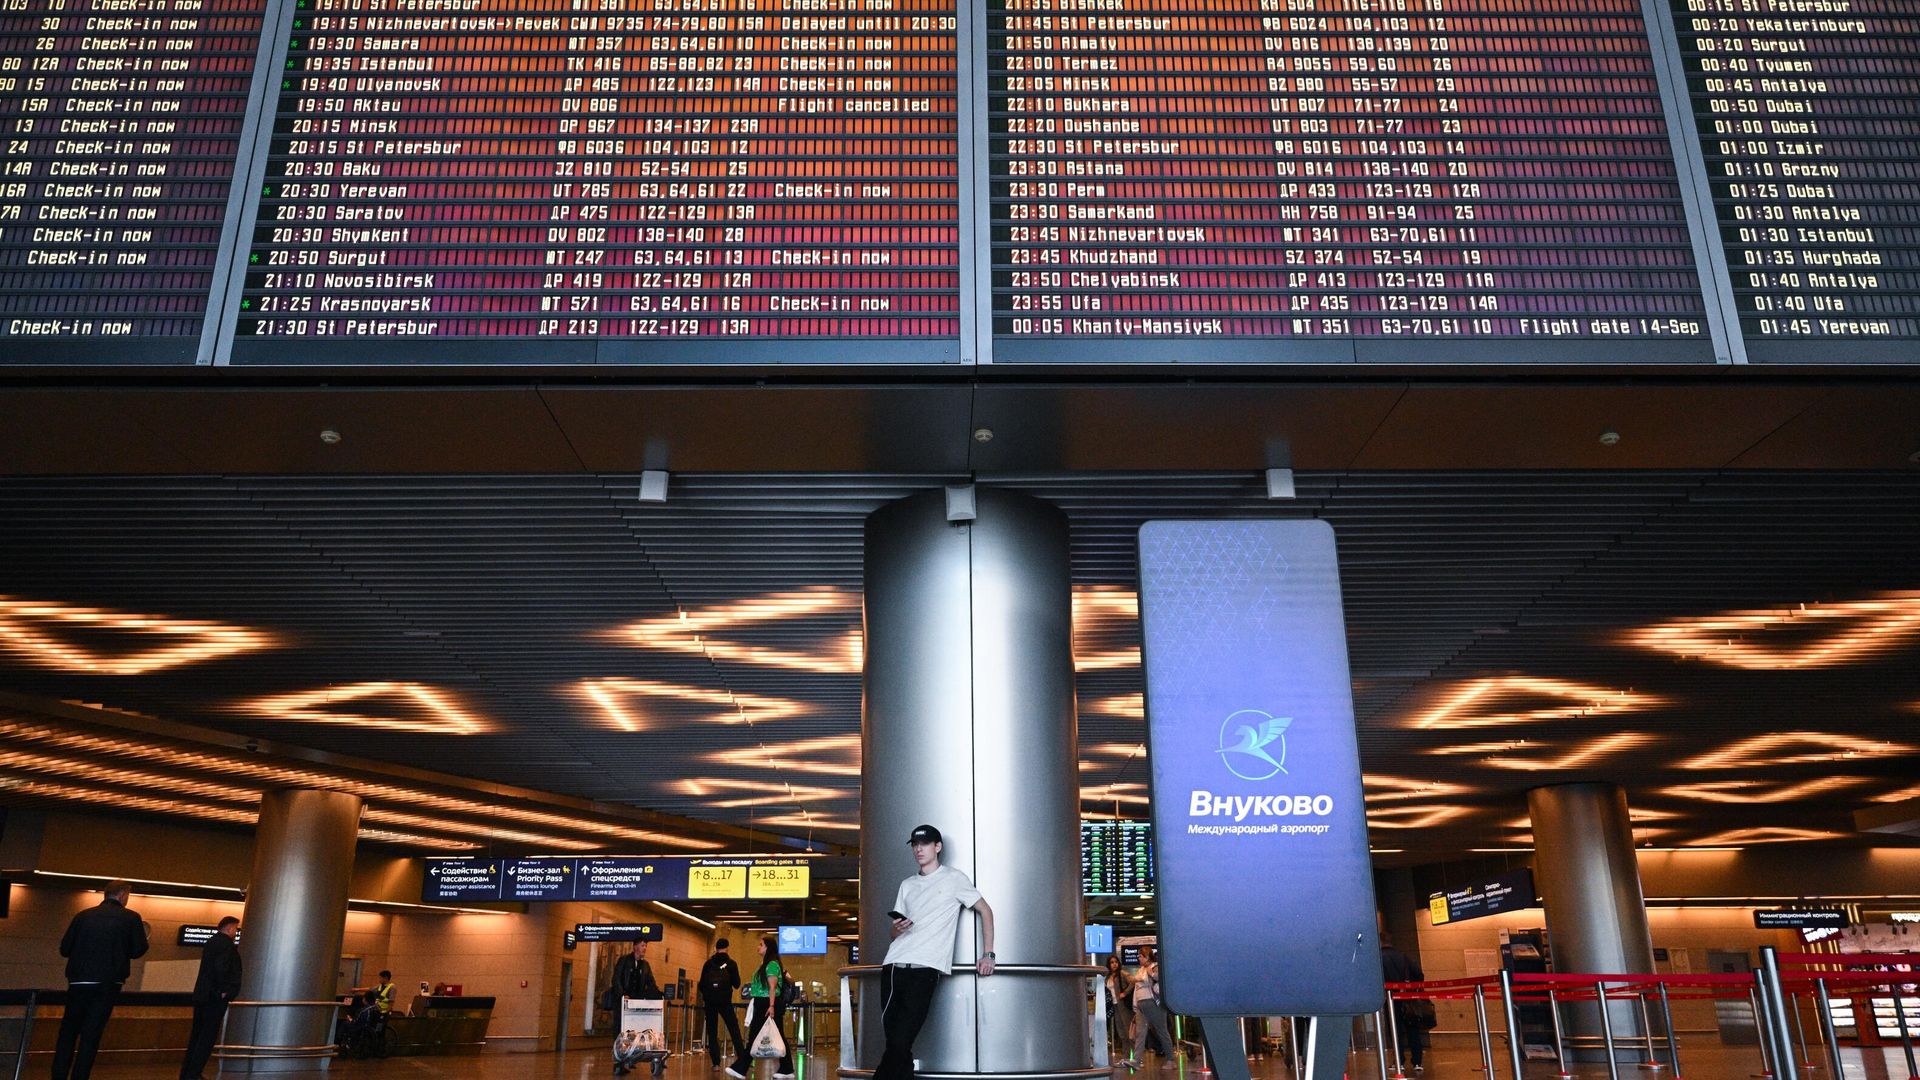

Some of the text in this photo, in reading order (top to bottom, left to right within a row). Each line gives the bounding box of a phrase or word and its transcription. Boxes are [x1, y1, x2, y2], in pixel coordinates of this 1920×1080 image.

[42, 17, 198, 30] 30 Check-in now
[314, 17, 359, 30] 19:15
[782, 16, 846, 31] Delayed
[857, 16, 900, 30] until
[912, 16, 956, 30] 20:30
[1006, 16, 1171, 30] 21:45 St Petersbur
[1692, 18, 1866, 34] 00:20 Yekaterinburg
[310, 37, 419, 50] 19:30 Samara
[1007, 36, 1117, 51] 21:50 Almaty
[1697, 38, 1806, 53] 00:20 Surgut
[307, 57, 433, 71] 19:35 Istanbul
[1007, 56, 1053, 70] 22:00
[1063, 56, 1118, 70] Termez
[1294, 57, 1332, 71] 9055
[1350, 57, 1396, 72] 59,60
[1433, 57, 1452, 71] 26
[1701, 58, 1813, 73] 00:40 Tyumen
[303, 77, 441, 92] 19:40 Ulyanovsk
[1007, 76, 1110, 91] 22:05 Minsk
[1706, 78, 1827, 94] 00:45 Antalya
[299, 98, 345, 112] 19:50
[354, 98, 401, 112] Aktau
[590, 98, 618, 112] 806
[779, 98, 833, 113] Flight
[846, 98, 930, 112] cancelled
[1008, 97, 1130, 112] 22:10 Bukhara
[1711, 99, 1813, 113] 00:50 Dubai
[293, 119, 398, 133] 20:15 Minsk
[1008, 118, 1140, 133] 22:20 Dushanbe
[1715, 120, 1818, 134] 01:00 Dubai
[9, 140, 171, 154] 24 Check-in now
[289, 140, 462, 154] 20:15 St Petersbur
[1009, 139, 1179, 154] 22:30 St Petersbur
[1720, 141, 1824, 155] 01:00 Izmir
[285, 161, 381, 176] 20:30 Baku
[1009, 160, 1124, 175] 23:30 Astana
[1725, 162, 1839, 178] 01:10 Grozny
[281, 183, 891, 199] 20:30 Yerevan UT 785 63,64,61 22 Check-in now
[1010, 182, 1105, 197] 23:30 Perm
[1730, 184, 1835, 198] 01:25 Dubai
[277, 205, 404, 220] 20:30 Saratov
[1010, 204, 1155, 219] 23:30 Samarkand
[1735, 205, 1861, 222] 01:30 Antalya
[273, 227, 409, 244] 20:30 Shymkent
[1011, 226, 1205, 242] 23:45 Nizhnevartovsk
[1740, 227, 1874, 243] 01:30 Istanbul
[269, 250, 386, 267] 20:50 Surgut
[1012, 249, 1158, 264] 23:45 Khudzhand
[1745, 250, 1882, 267] 01:35 Hurghada
[265, 273, 434, 288] 21:10 Novosibirsk
[1012, 271, 1180, 289] 23:50 Chelyabinsk
[1750, 272, 1878, 289] 01:40 Antalya
[261, 296, 432, 313] 21:25 Krasnoyarsk
[1013, 295, 1101, 310] 23:55 Ufa
[1755, 296, 1844, 311] 01:40 Ufa
[10, 319, 132, 335] Check-in now
[256, 319, 438, 335] 21:30 St Petersbur
[1013, 318, 1700, 336] 00:05 Khanty-Mansiysk Flight date 14-Sep
[1760, 319, 1890, 335] 01:45 Yerevan
[1189, 790, 1333, 822] Внуково
[1187, 824, 1330, 835] Международный аэропорт
[441, 867, 488, 875] Содействие
[517, 867, 561, 875] Бизнес-зал
[591, 866, 644, 875] Оформление
[516, 875, 544, 883] Priority
[590, 875, 641, 883] спецсредств
